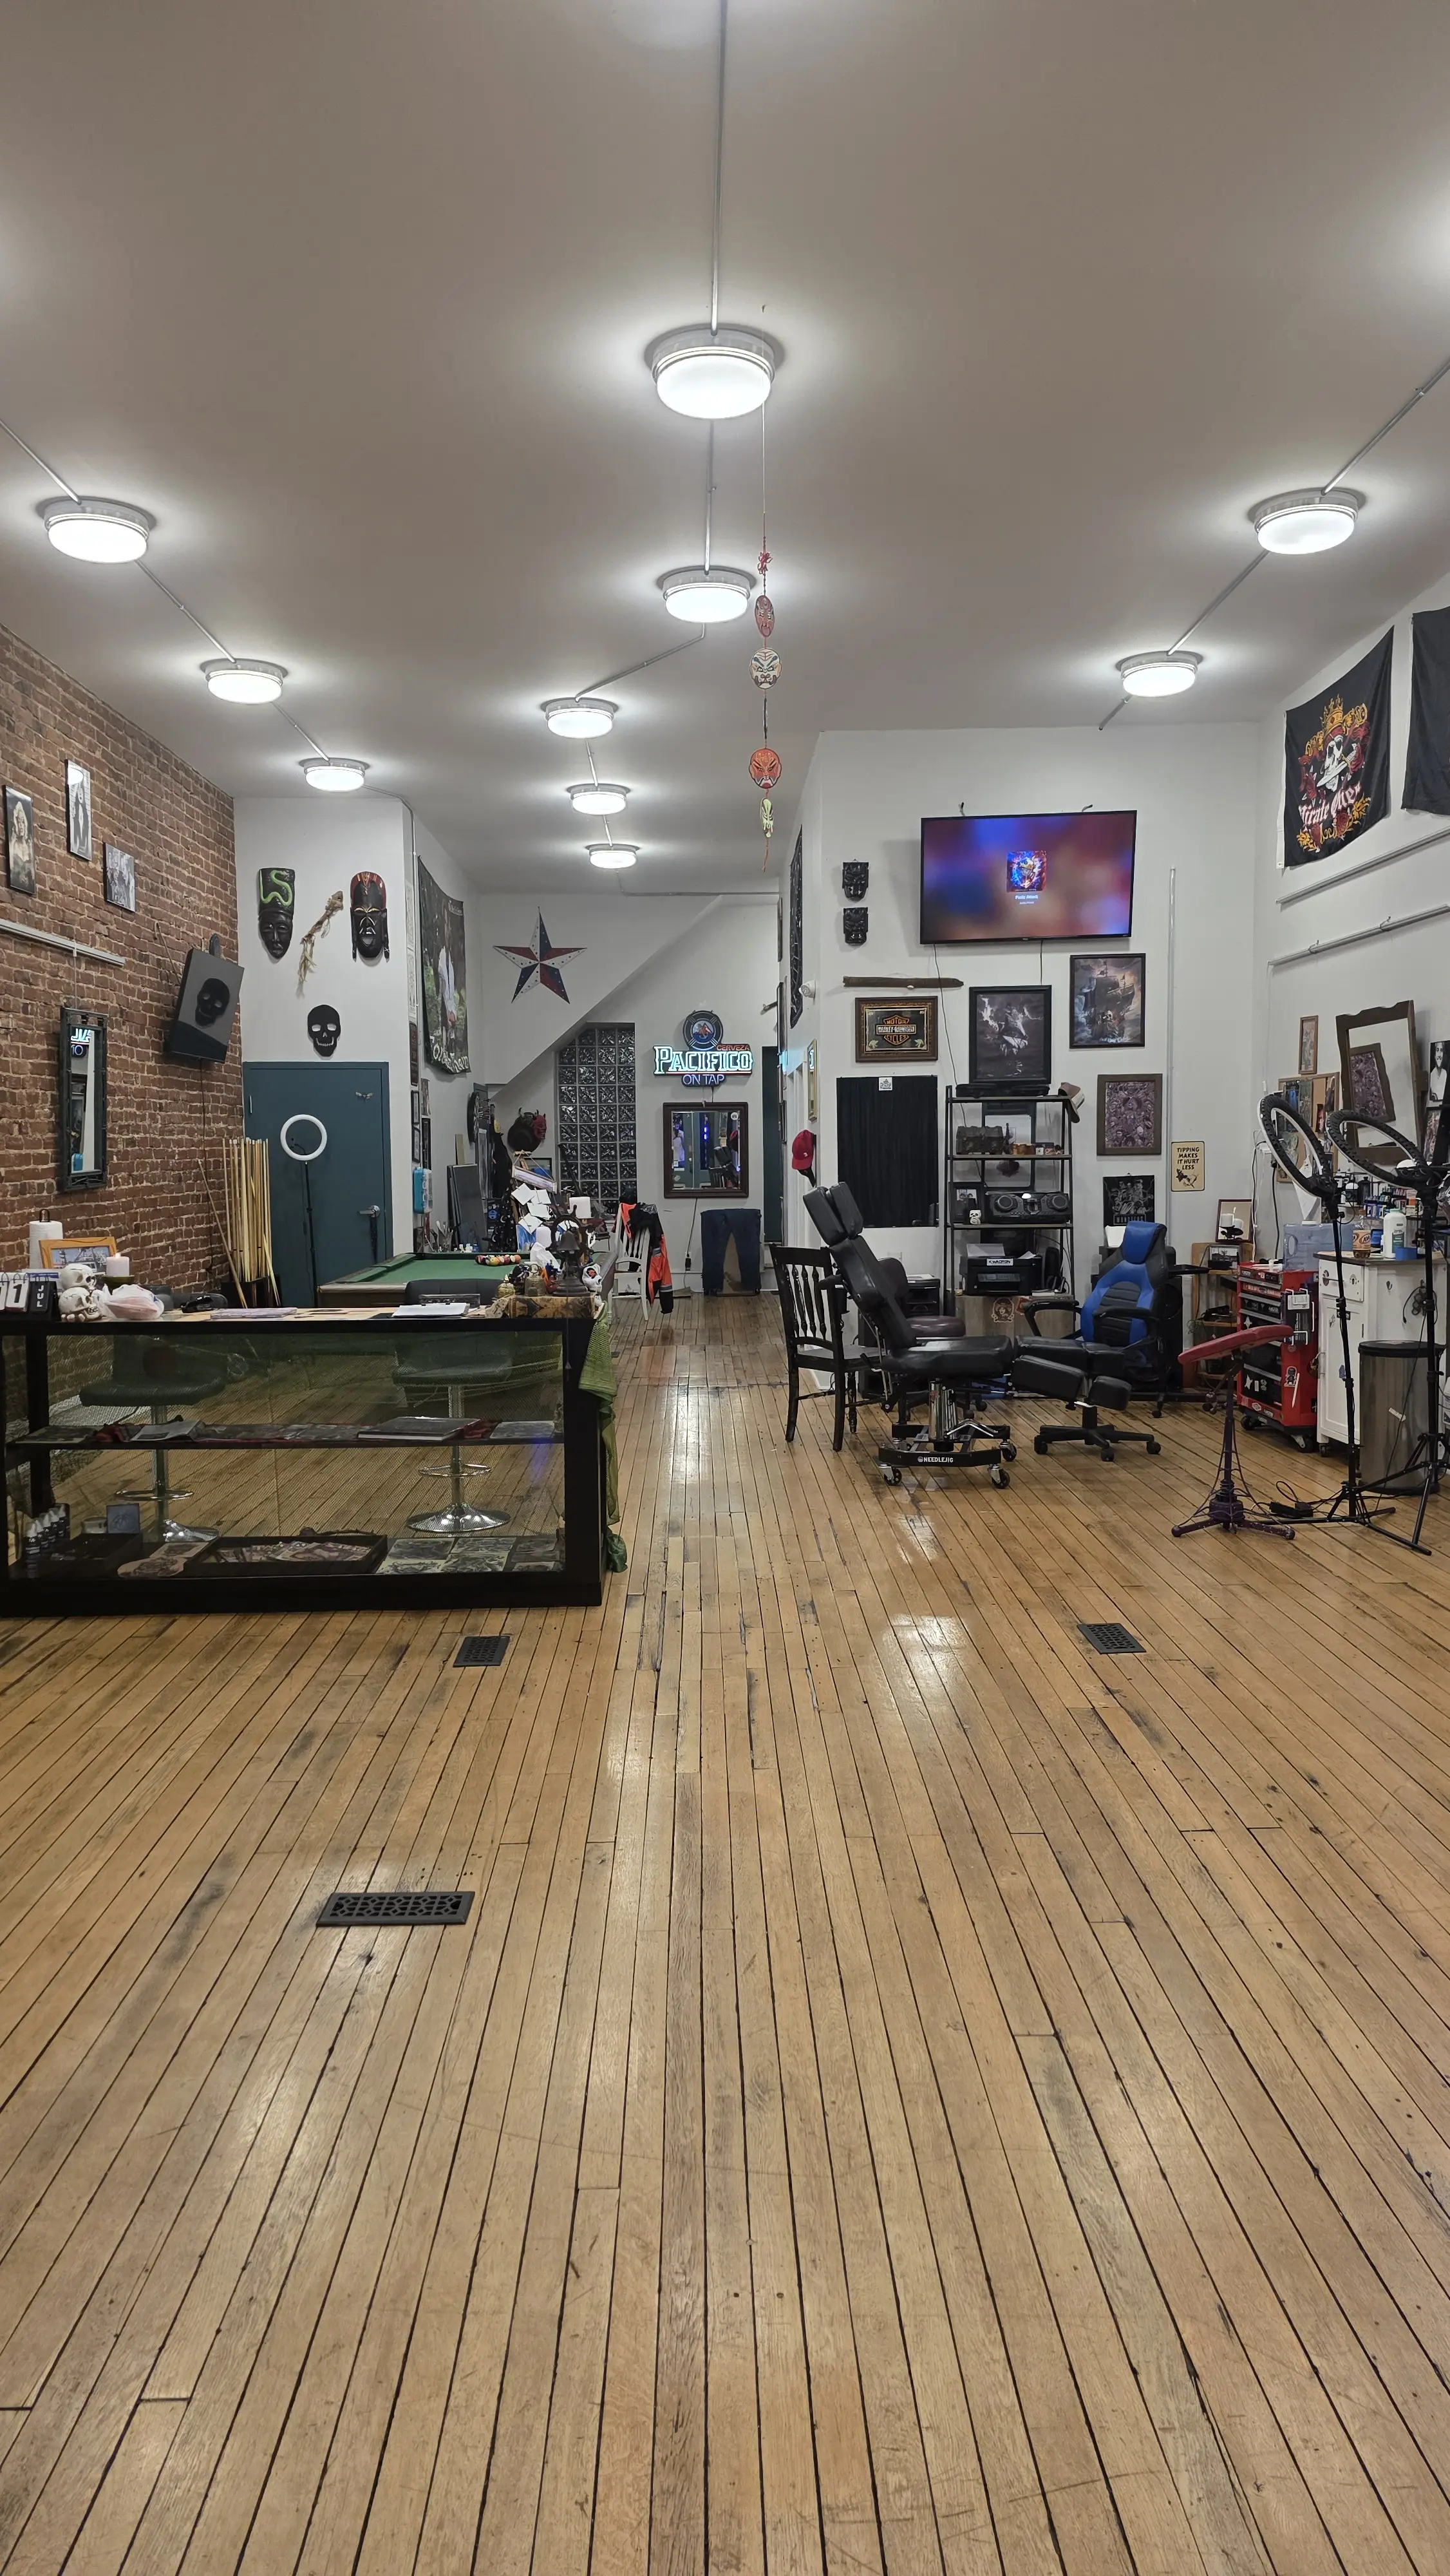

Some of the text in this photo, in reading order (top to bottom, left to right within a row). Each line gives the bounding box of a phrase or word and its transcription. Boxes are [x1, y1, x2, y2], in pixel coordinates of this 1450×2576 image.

[886, 1035, 907, 1043] CYCLES
[654, 1046, 753, 1074] PACIFICO
[683, 1074, 725, 1085] ON TAP
[13, 1284, 23, 1303] 1
